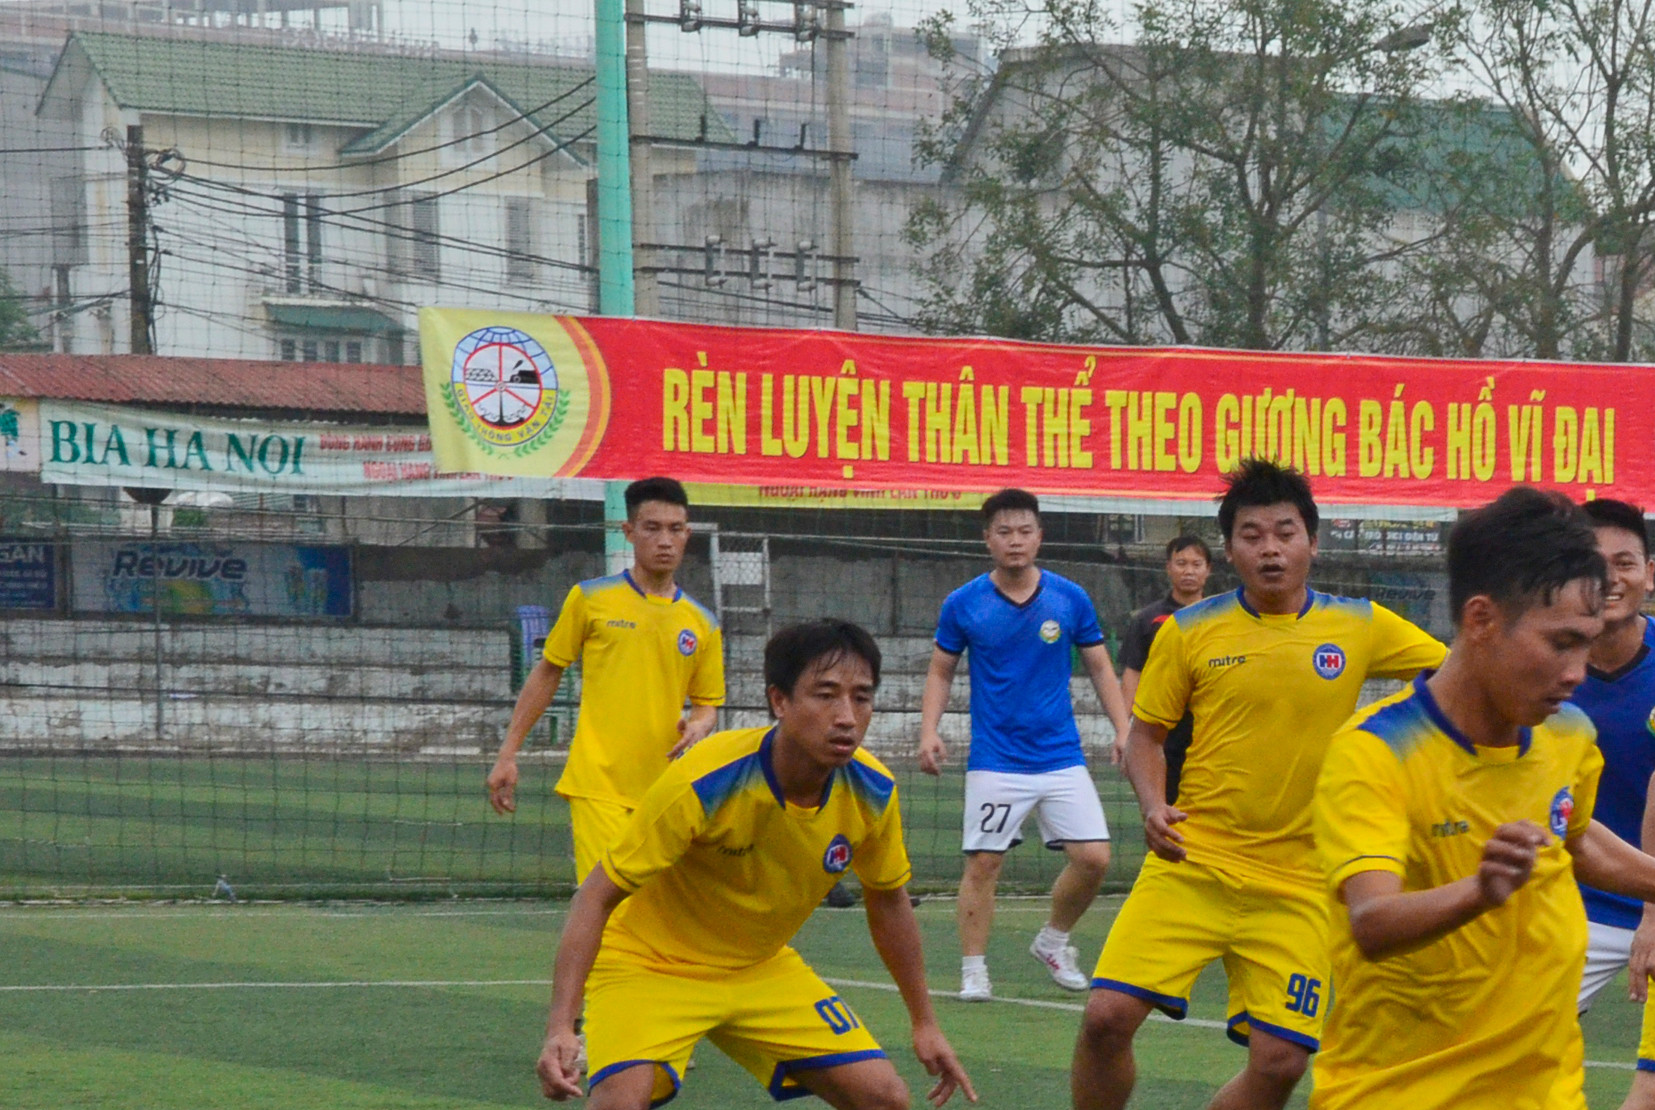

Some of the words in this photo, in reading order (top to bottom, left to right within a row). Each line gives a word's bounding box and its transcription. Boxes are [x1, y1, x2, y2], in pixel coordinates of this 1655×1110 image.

[48, 420, 131, 466] BIA
[664, 352, 746, 454] RÈN
[762, 360, 890, 478] LUYỆN
[903, 366, 1009, 465] THÂN
[1021, 356, 1096, 468] THỂ
[1106, 391, 1202, 473] THEO
[1216, 388, 1347, 477] GƯƠNG
[1359, 384, 1434, 479] BÁC
[1447, 377, 1496, 481] HỒ
[1509, 390, 1546, 481] VĨ
[1554, 407, 1614, 501] ĐẠI
[113, 549, 248, 580] Revive
[1208, 655, 1246, 668] mitre
[980, 803, 1012, 834] 27
[1285, 973, 1322, 1018] 96
[814, 996, 860, 1035] 07
